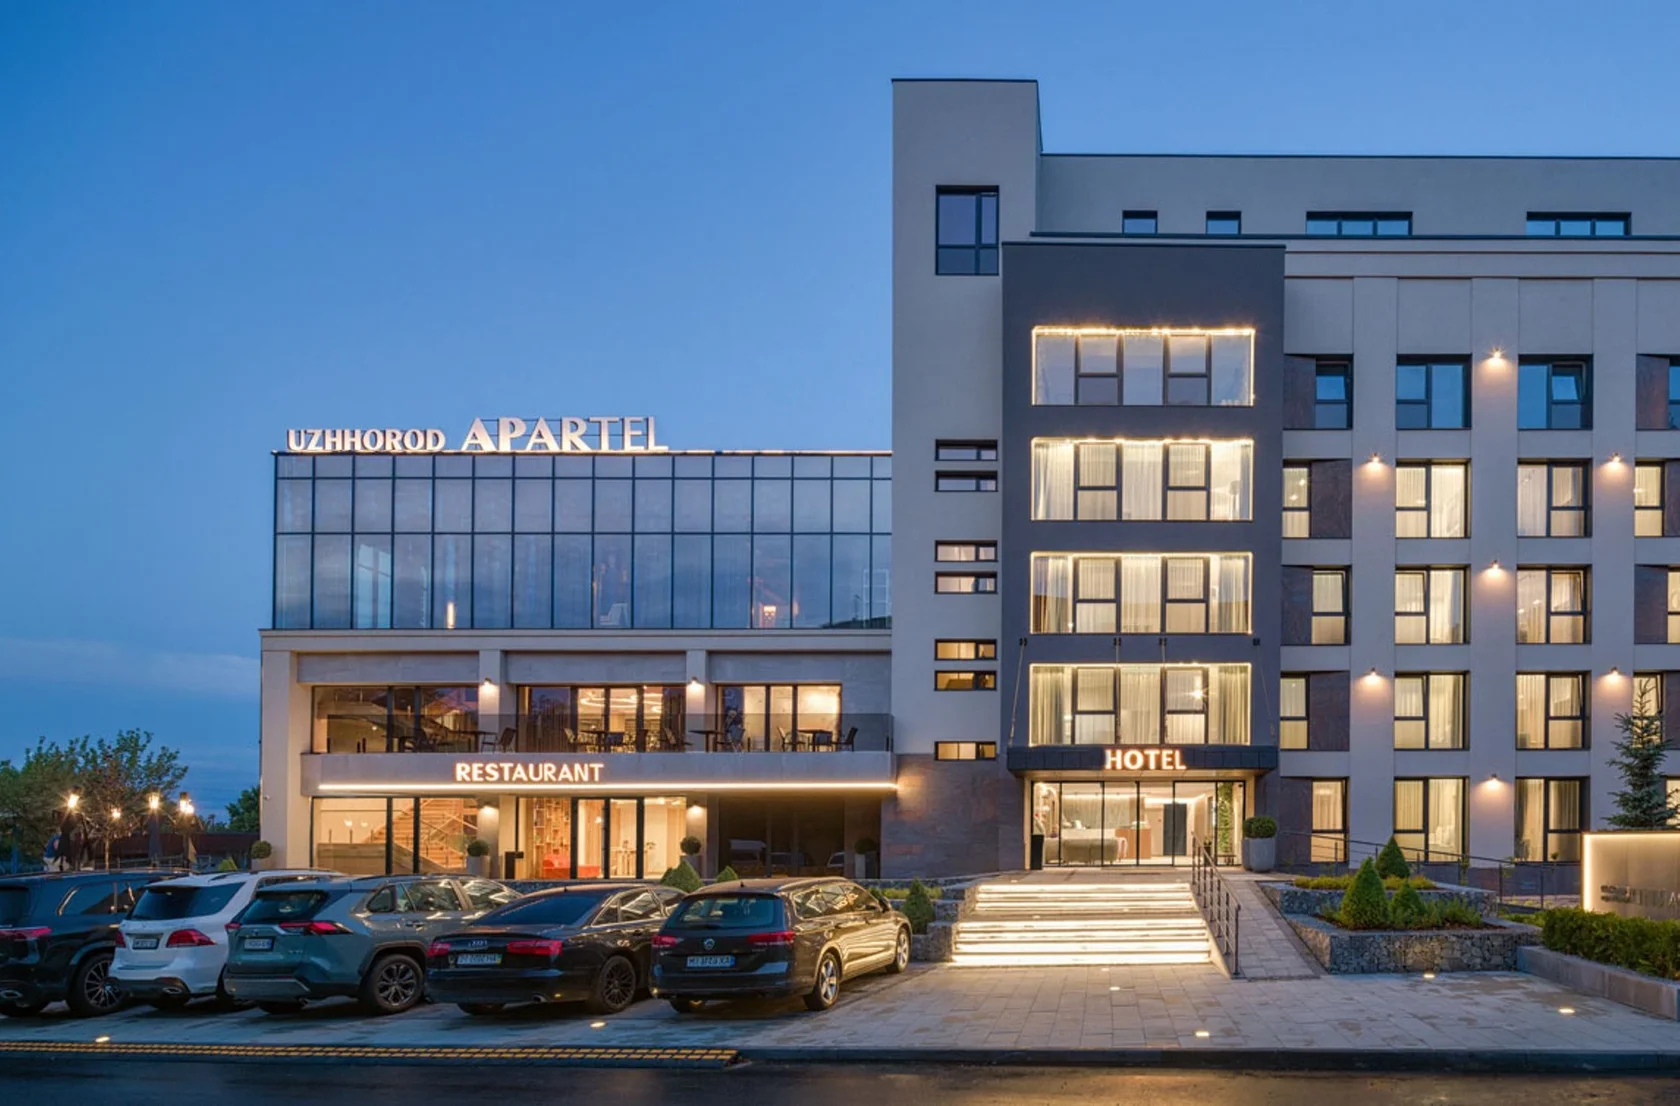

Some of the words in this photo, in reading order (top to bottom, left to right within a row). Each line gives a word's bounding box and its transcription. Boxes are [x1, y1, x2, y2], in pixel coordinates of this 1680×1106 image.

[286, 428, 446, 452] UZHHOROD
[461, 416, 669, 452] APARTEL
[1104, 748, 1187, 770] HOTEL
[455, 762, 605, 782] RESTAURANT
